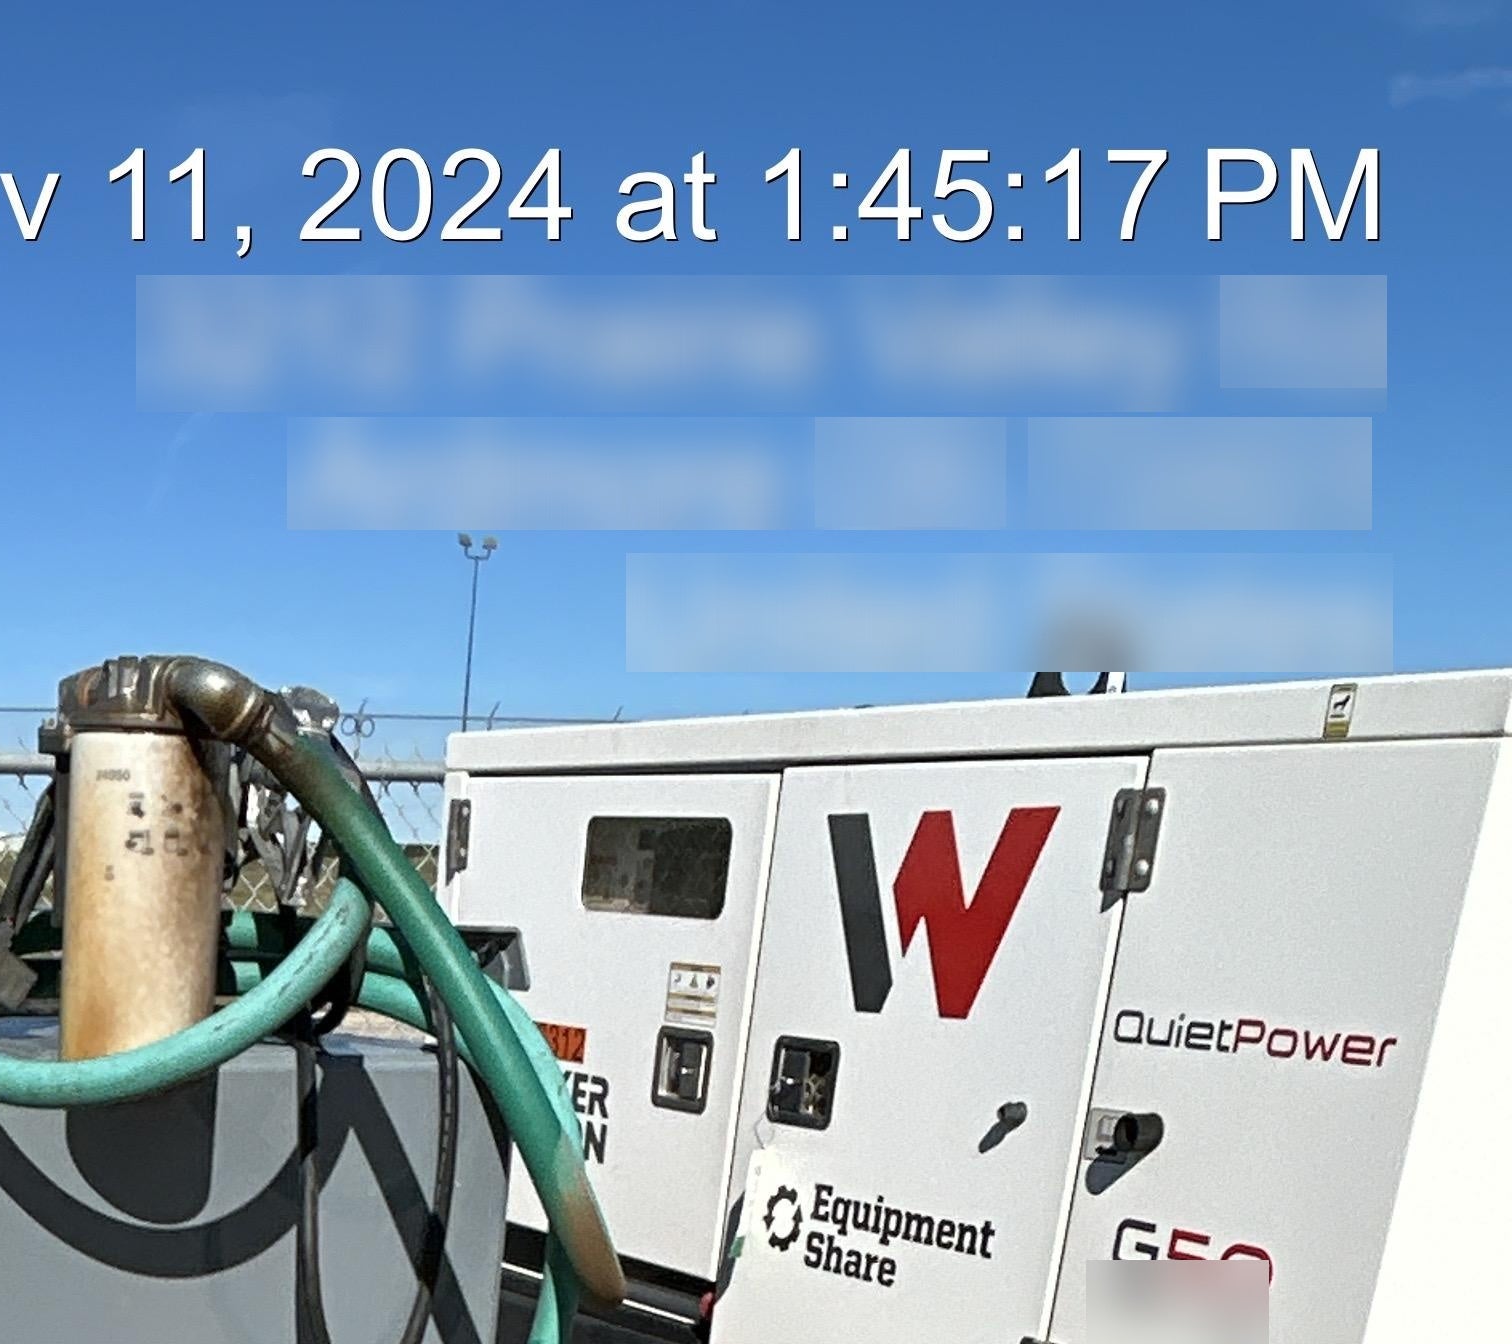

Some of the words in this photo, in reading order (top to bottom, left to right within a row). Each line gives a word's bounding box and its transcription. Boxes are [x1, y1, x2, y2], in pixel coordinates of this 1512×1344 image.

[1113, 1009, 1398, 1067] QuietPower
[810, 1183, 996, 1259] Equipment
[803, 1231, 898, 1288] Share
